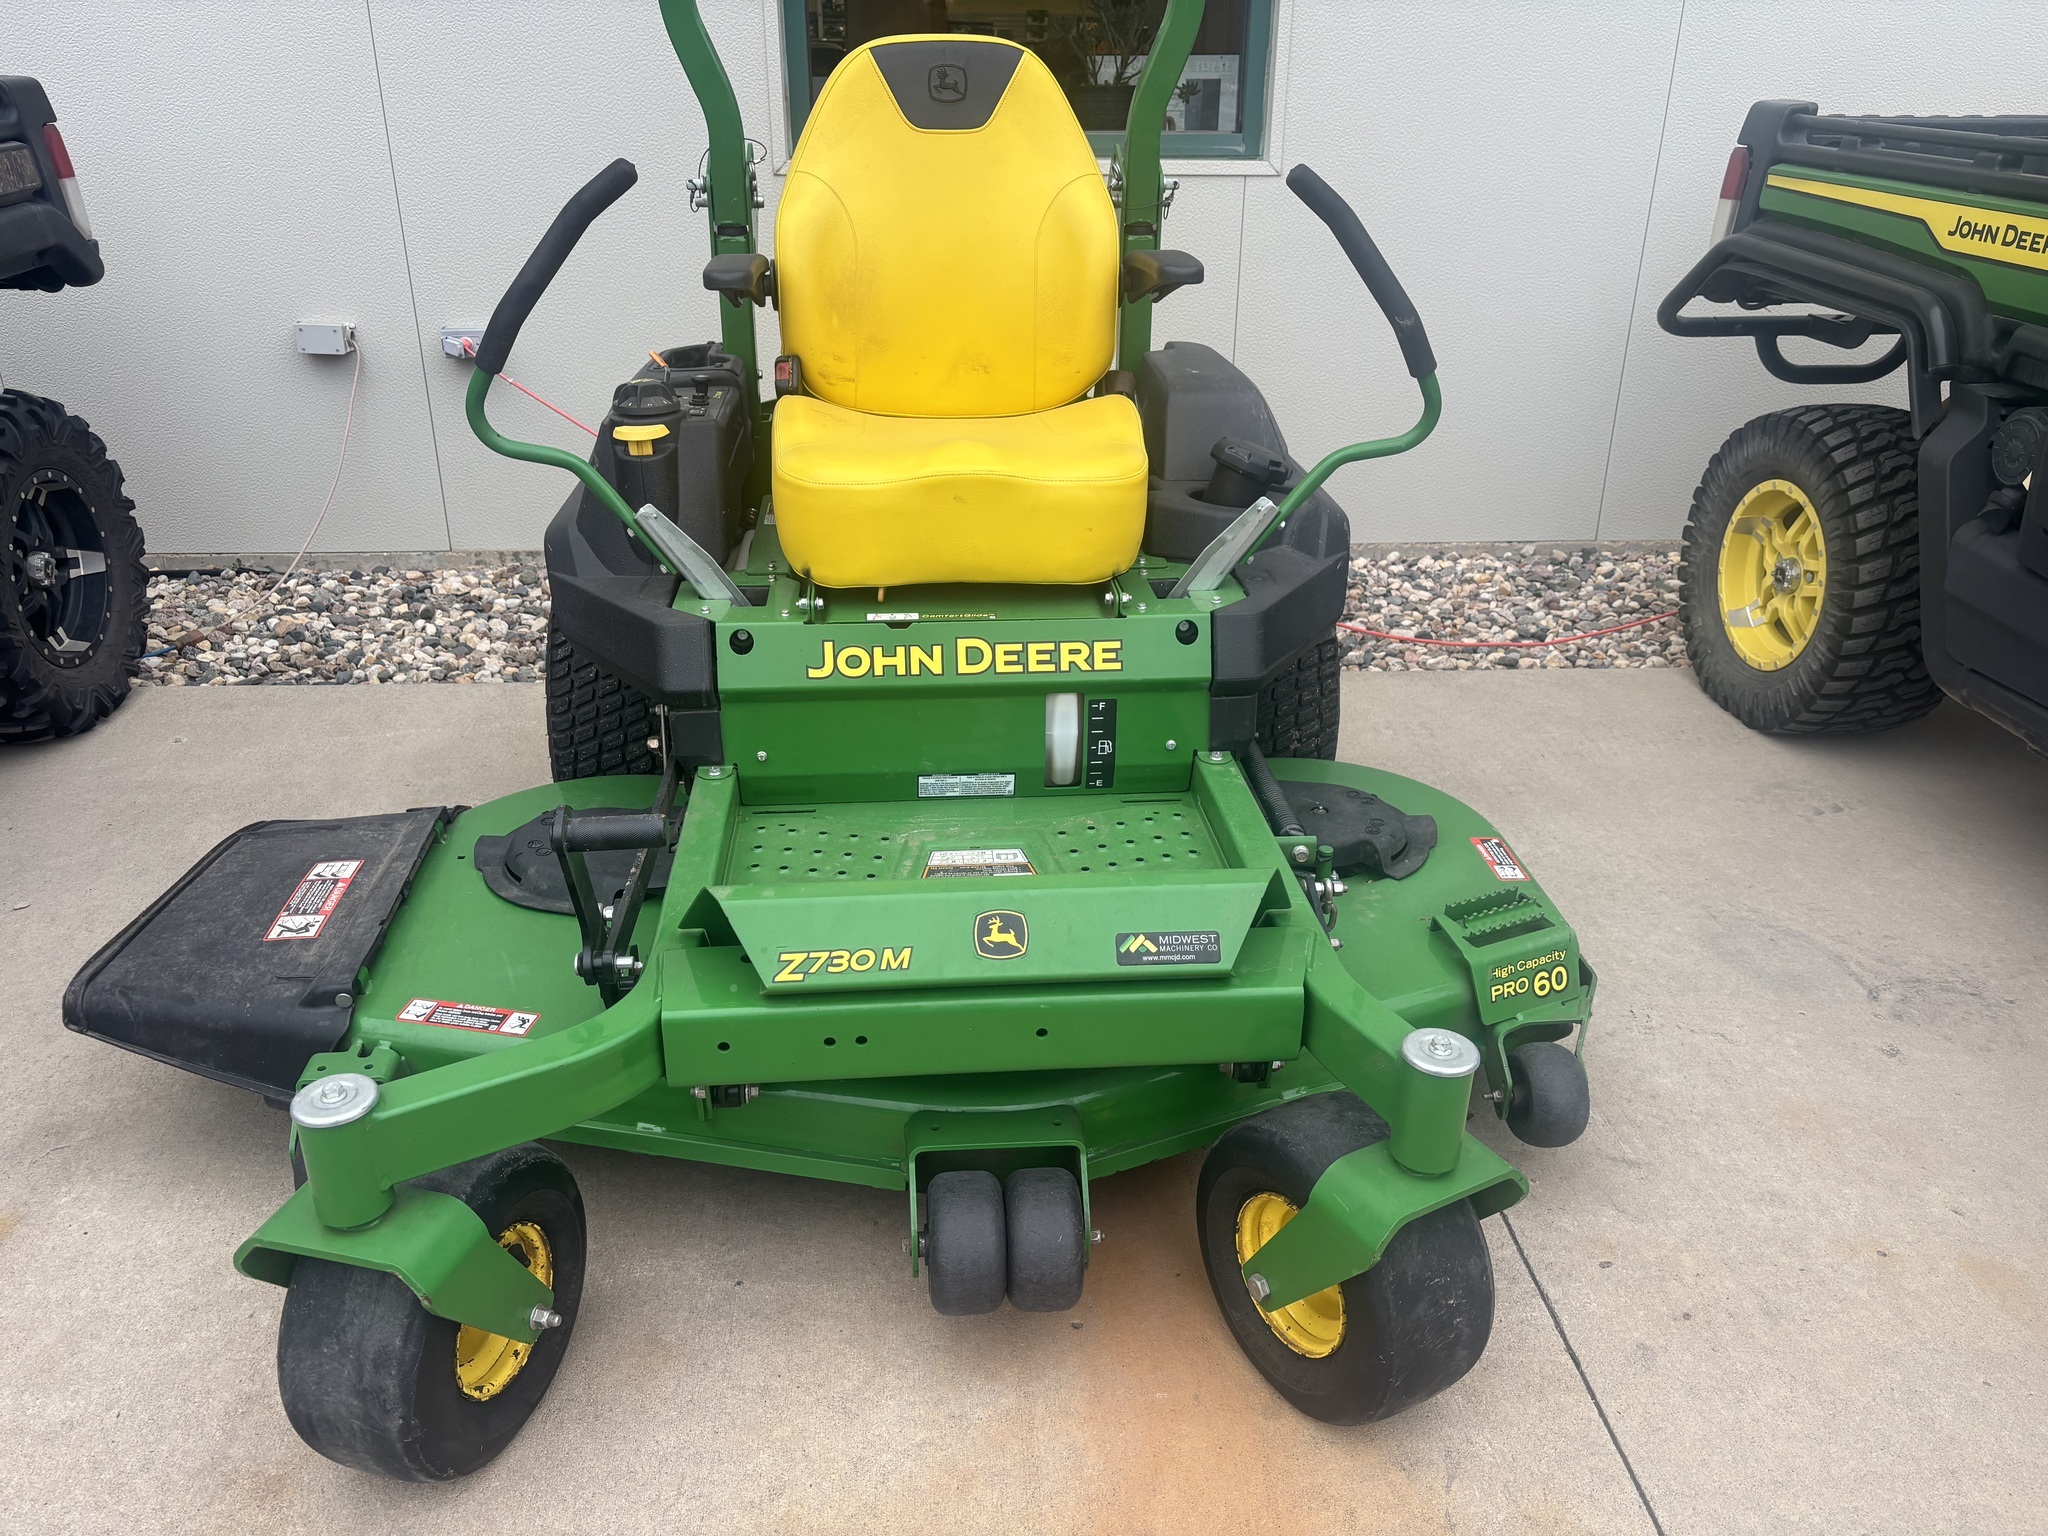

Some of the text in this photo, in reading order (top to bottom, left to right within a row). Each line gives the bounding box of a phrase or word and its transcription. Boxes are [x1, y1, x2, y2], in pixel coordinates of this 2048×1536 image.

[1947, 215, 2000, 244] JOHN
[806, 636, 1123, 679] JOHN DEERE
[1099, 702, 1106, 711] F
[1095, 779, 1104, 787] E
[322, 887, 344, 911] DANGER
[1158, 934, 1218, 945] MIDWEST
[1159, 943, 1218, 952] MACHINERY CO
[1142, 953, 1196, 962] www.mmcjd.com
[1491, 949, 1567, 979] High Capacity
[1490, 964, 1569, 1003] PRO 60
[463, 1003, 497, 1013] DANGER
